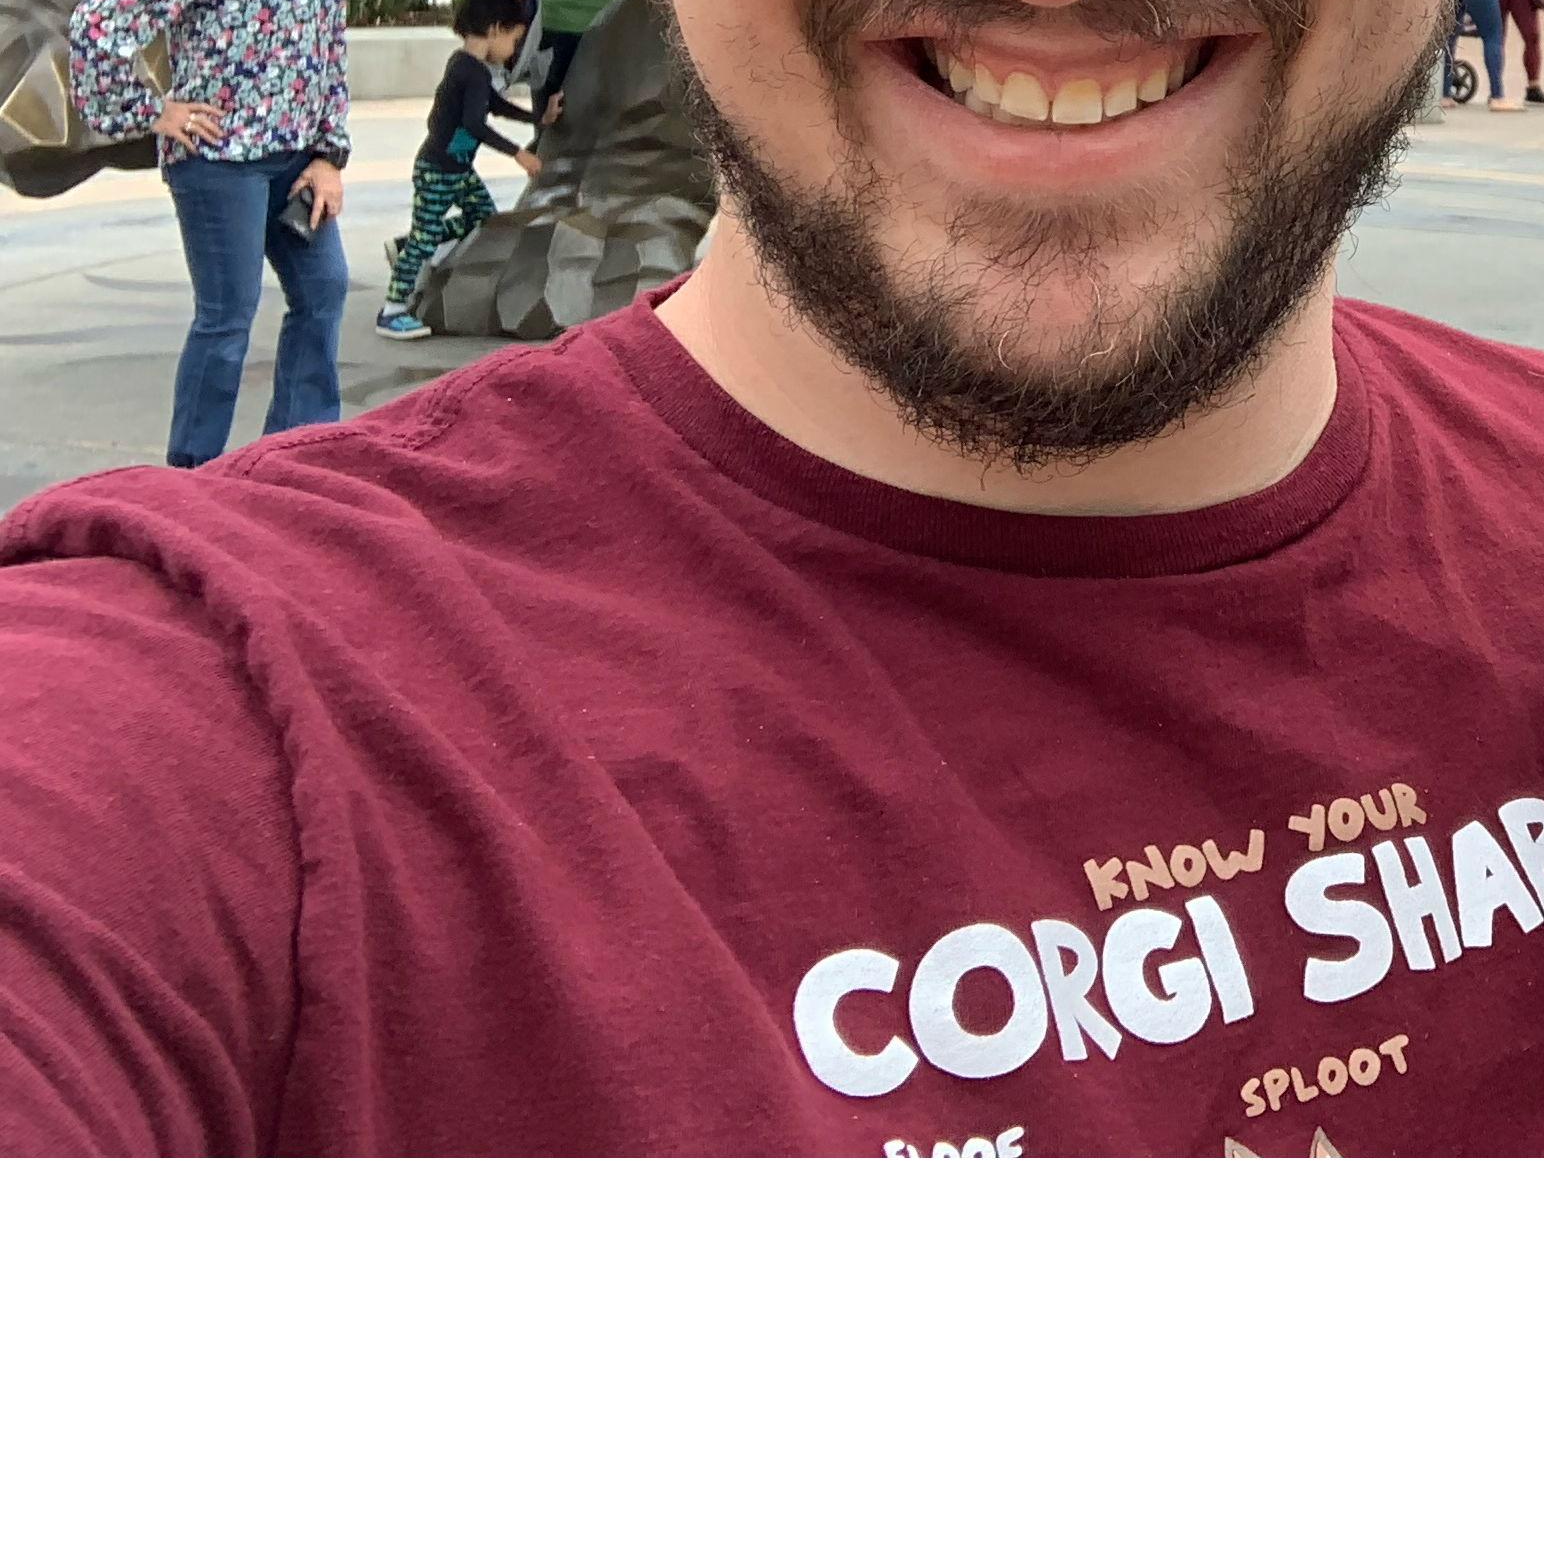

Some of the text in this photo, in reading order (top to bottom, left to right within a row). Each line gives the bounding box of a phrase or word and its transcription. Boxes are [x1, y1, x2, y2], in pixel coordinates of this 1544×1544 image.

[1083, 782, 1428, 912] KNOW YOUR
[793, 896, 1255, 1098] CORGI
[1240, 1035, 1410, 1117] SPLOOT
